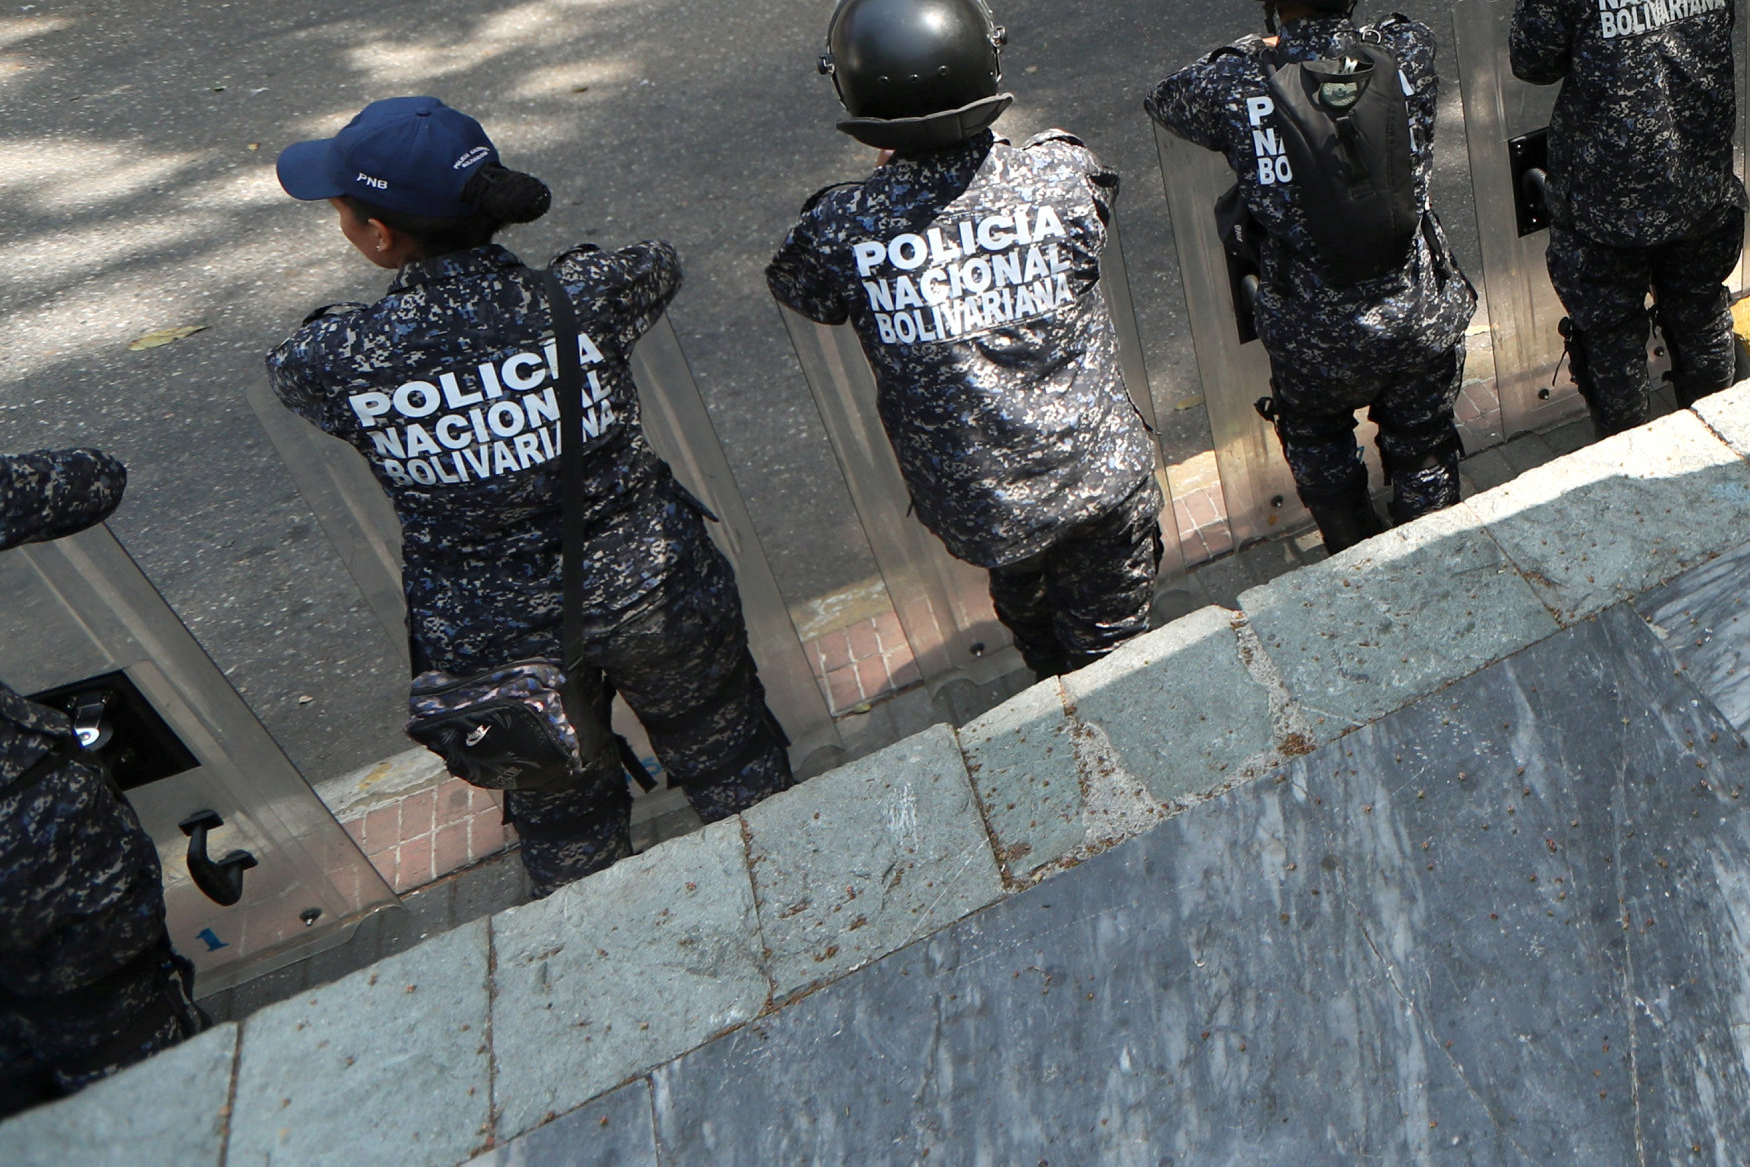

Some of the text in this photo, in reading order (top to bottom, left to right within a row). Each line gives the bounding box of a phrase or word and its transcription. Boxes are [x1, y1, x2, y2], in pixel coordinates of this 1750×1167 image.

[356, 172, 388, 190] PNB
[861, 242, 1071, 312] NACIONAL
[874, 272, 1074, 345] BOLIVARIANA
[384, 397, 617, 486] BOLIVARINA
